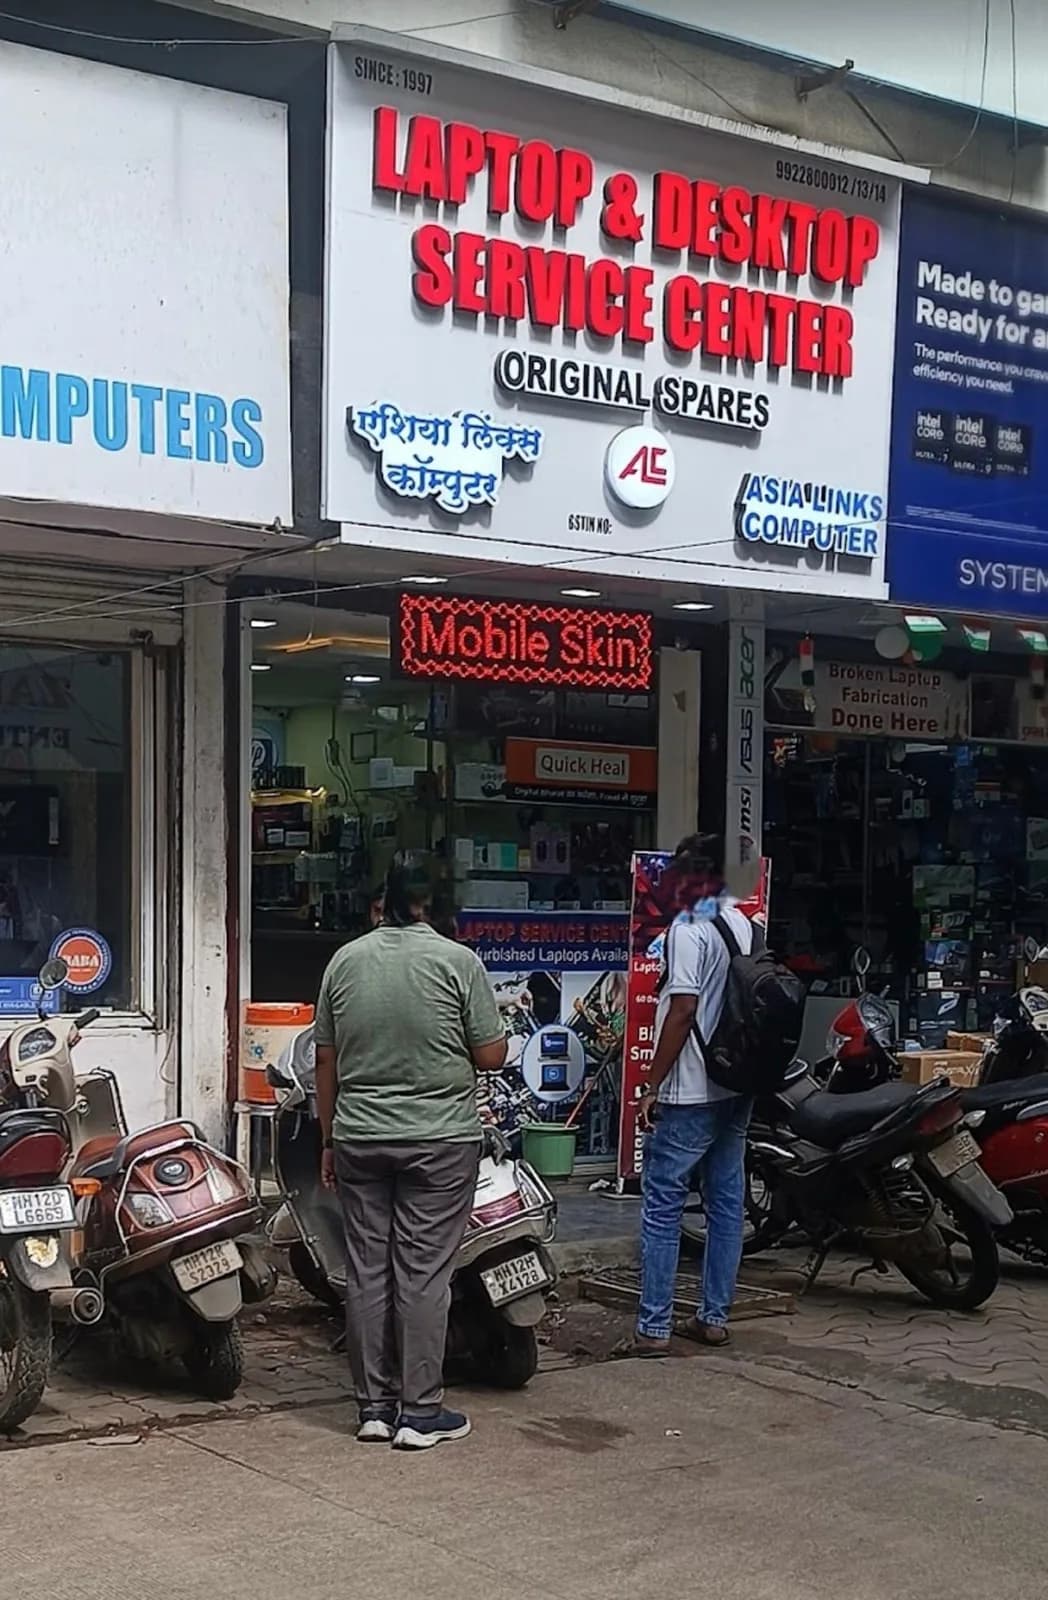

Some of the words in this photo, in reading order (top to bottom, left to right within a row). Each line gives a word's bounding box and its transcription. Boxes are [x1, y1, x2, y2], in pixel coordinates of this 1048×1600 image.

[373, 106, 593, 227] LAPTOP
[601, 171, 644, 242] &
[653, 170, 880, 287] DESKTOP
[412, 223, 654, 343] SERVICE
[666, 274, 854, 378] CENTER
[917, 260, 985, 301] Made
[989, 279, 1013, 306] to
[1017, 290, 1048, 316] ga
[916, 296, 993, 343] Ready
[996, 314, 1030, 344] for
[1032, 328, 1048, 350] a
[912, 363, 964, 386] efficiency
[966, 375, 985, 388] you
[913, 342, 936, 359] The
[937, 351, 1002, 373] performance
[1004, 363, 1023, 376] you
[502, 350, 650, 409] ORIGINAL
[660, 376, 770, 429] SPARES
[0, 365, 264, 468] MPUTERS
[357, 404, 452, 446] एशिया
[917, 411, 941, 428] intel
[955, 414, 983, 434] intel
[998, 426, 1021, 442] intel
[746, 475, 804, 509] ASIA
[813, 485, 883, 522] LINKS
[744, 511, 878, 554] COMPUTER
[420, 610, 551, 664] Mobile
[559, 624, 638, 670] Skin
[740, 626, 756, 699] acer
[829, 662, 883, 682] Broken
[842, 687, 928, 708] Fabrication
[831, 707, 883, 730] Done
[890, 710, 939, 732] Here
[540, 754, 586, 774] Quick
[591, 758, 626, 777] Heal
[740, 787, 752, 832] msi
[520, 922, 585, 943] SERVICE
[538, 947, 589, 964] Laptops
